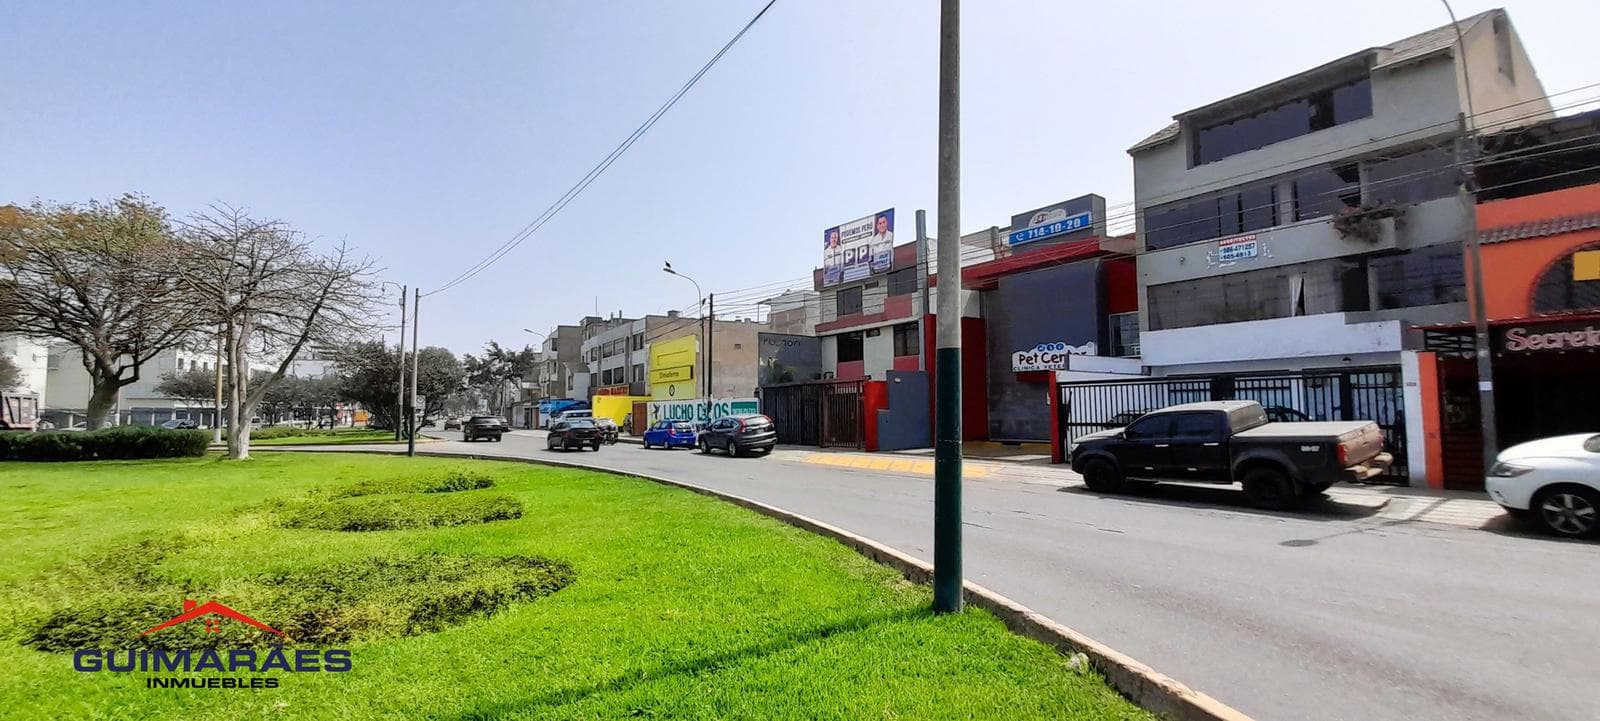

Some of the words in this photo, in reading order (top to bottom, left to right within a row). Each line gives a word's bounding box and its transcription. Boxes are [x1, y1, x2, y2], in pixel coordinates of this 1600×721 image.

[1028, 218, 1081, 239] 714-10-20
[1019, 353, 1039, 365] Pet
[663, 403, 694, 420] LUCHO
